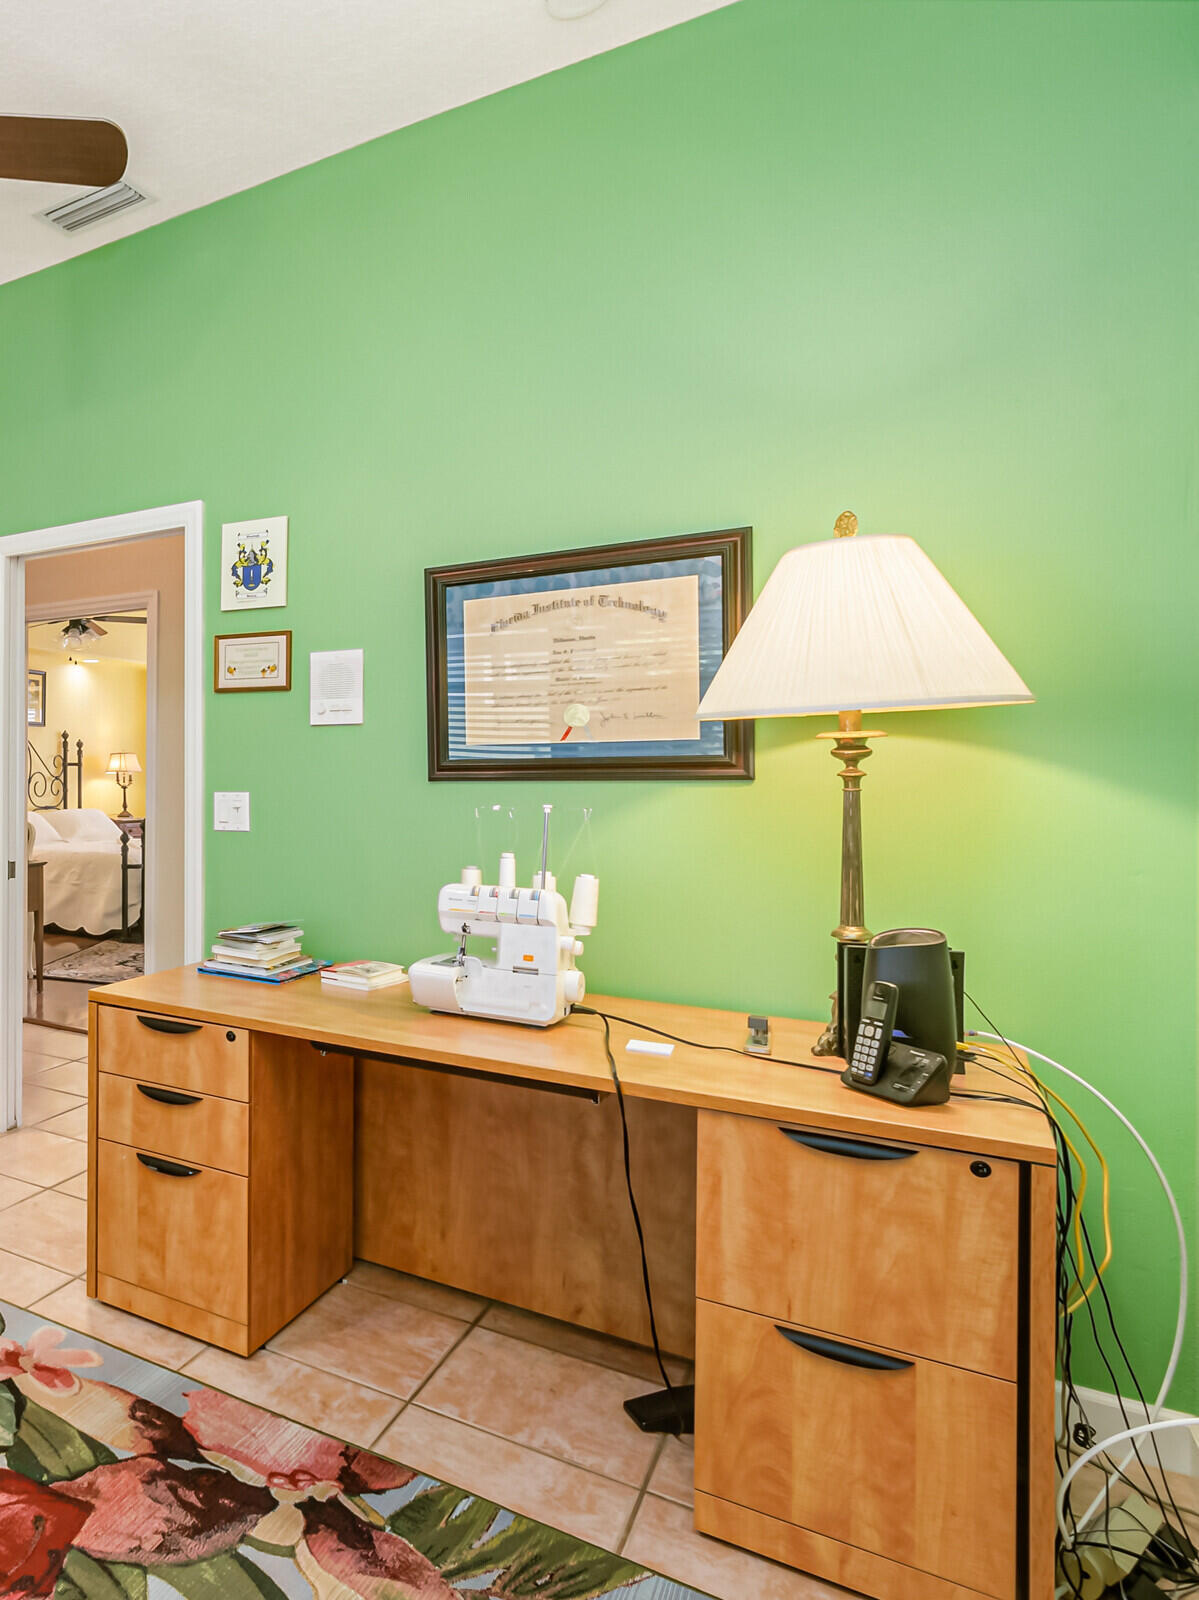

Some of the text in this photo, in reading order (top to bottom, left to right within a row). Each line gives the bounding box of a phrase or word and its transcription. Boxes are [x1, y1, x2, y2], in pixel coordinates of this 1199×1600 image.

[531, 598, 581, 615] Institute
[583, 595, 595, 607] of
[598, 594, 668, 623] Technology
